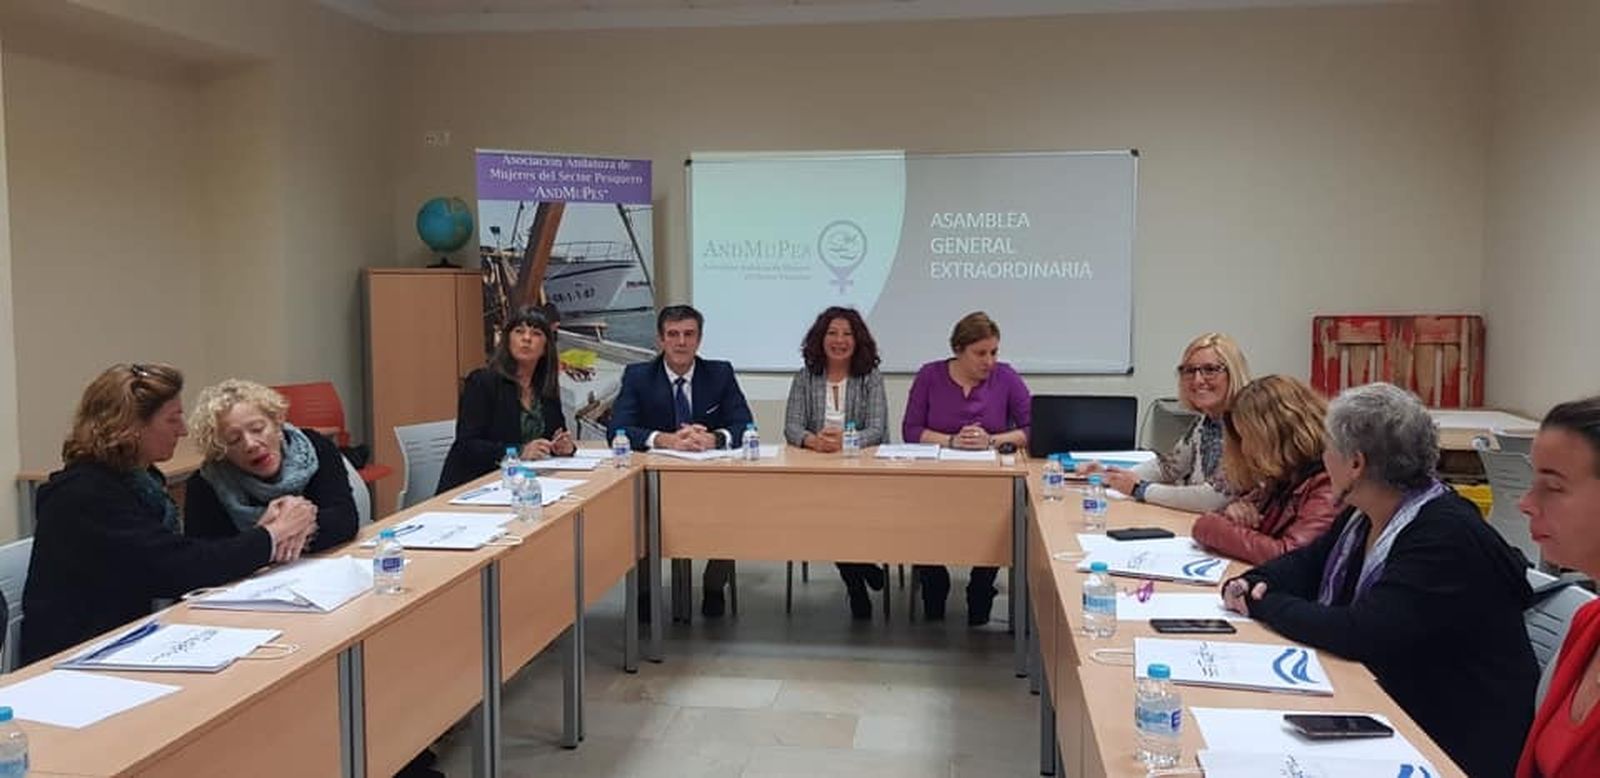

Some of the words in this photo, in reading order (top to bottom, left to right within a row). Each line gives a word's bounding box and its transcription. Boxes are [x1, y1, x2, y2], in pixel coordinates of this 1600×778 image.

[618, 159, 632, 170] de
[490, 168, 536, 181] Mujeres
[538, 170, 556, 181] del
[558, 172, 593, 183] Sector
[595, 173, 643, 185] Pesquero
[930, 212, 1030, 229] ASAMBLEA
[930, 237, 1015, 254] GENERAL
[930, 261, 1093, 280] EXTRAORDINARIA
